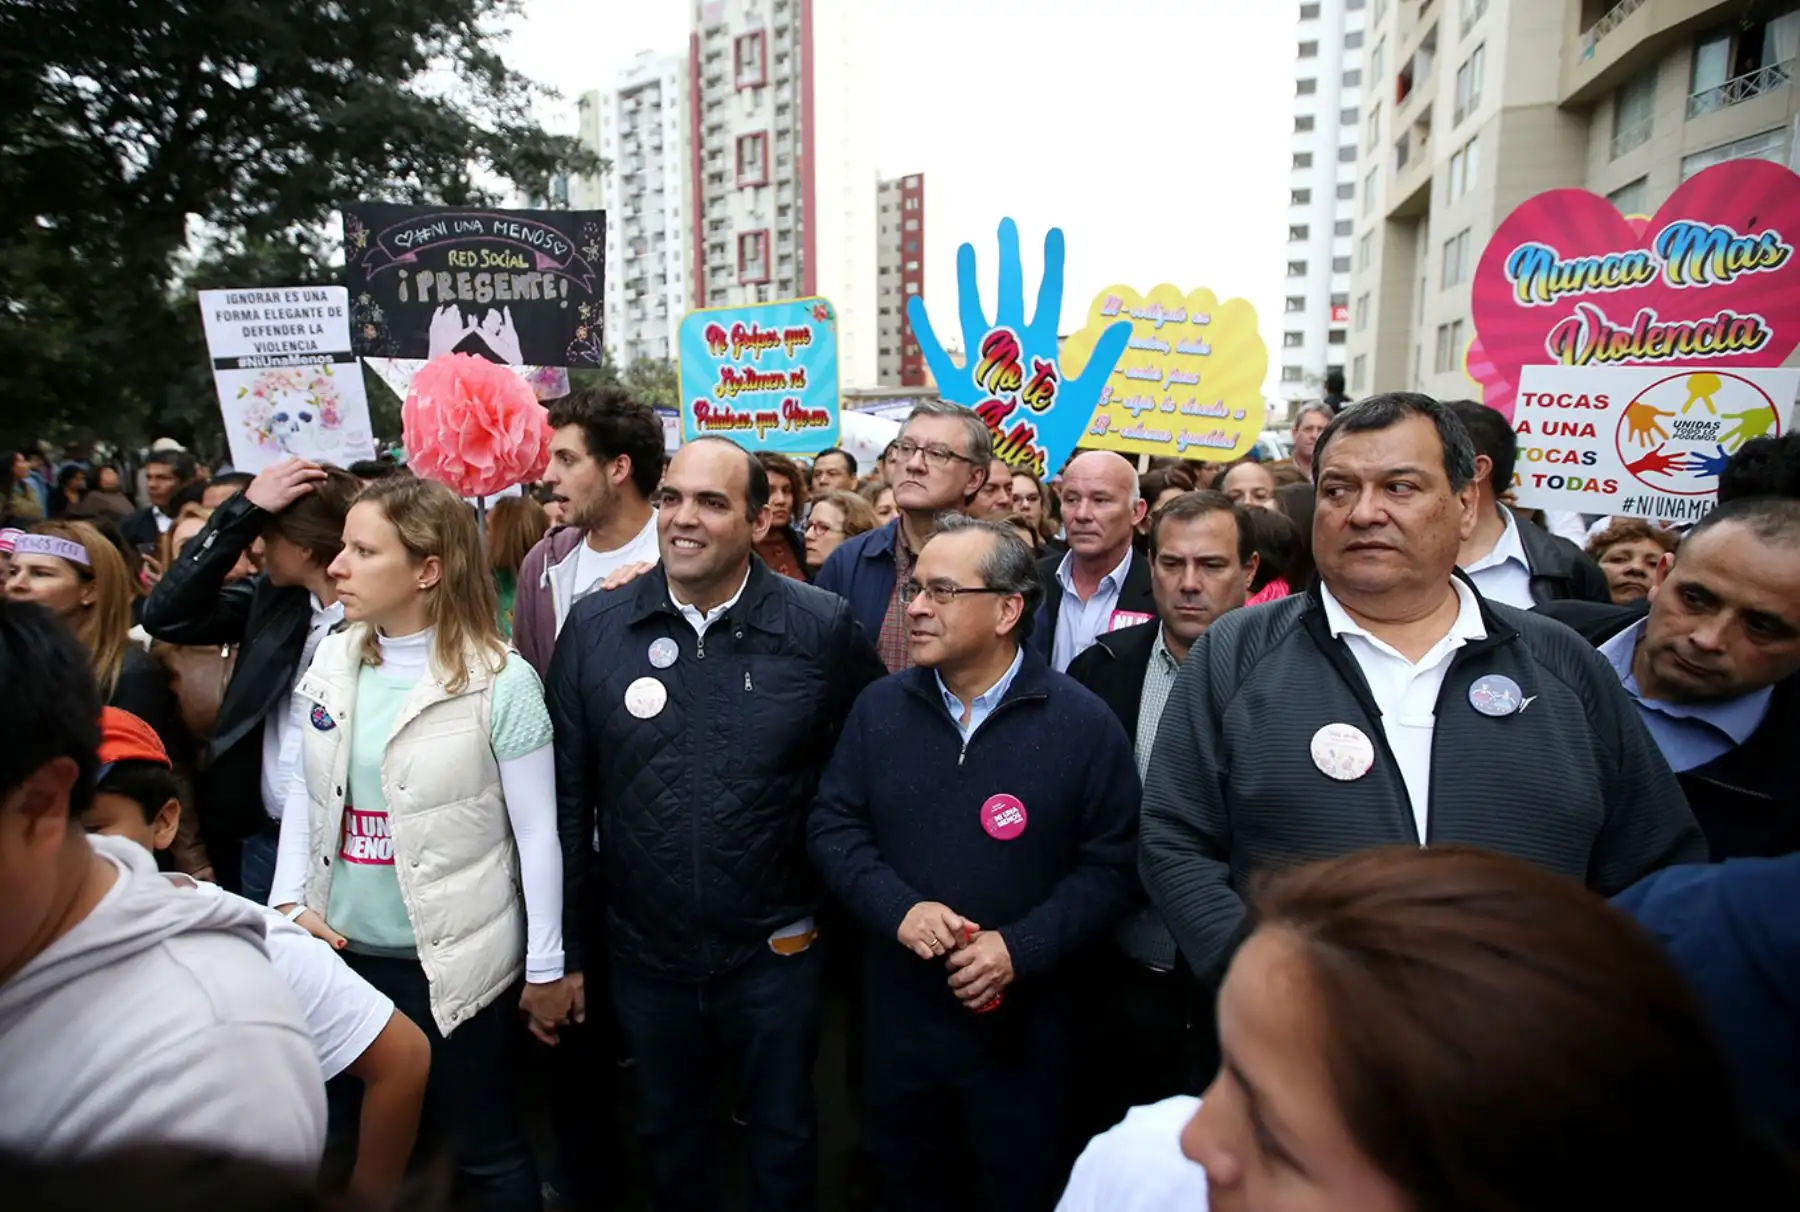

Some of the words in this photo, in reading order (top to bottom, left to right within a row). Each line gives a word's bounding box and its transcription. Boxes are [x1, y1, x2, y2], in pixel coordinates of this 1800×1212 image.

[414, 220, 448, 243] #NI
[454, 219, 484, 234] UNA
[493, 221, 555, 248] MENOS
[448, 249, 478, 267] RED
[1508, 244, 1656, 303] Nunca
[226, 291, 281, 305] IGNORAR
[285, 291, 300, 303] ES
[303, 290, 329, 302] UNA
[216, 309, 261, 322] FORMA
[264, 306, 322, 320] ELEGANTE
[327, 306, 343, 318] DE
[242, 324, 305, 338] DEFENDER
[310, 323, 324, 335] LA
[1549, 304, 1768, 366] Violencia
[254, 340, 318, 353] VIOLENCIA
[237, 353, 334, 370] #NiUnaMenos
[975, 329, 1023, 396] No
[1021, 359, 1058, 412] te
[1522, 393, 1610, 410] TOCAS
[1516, 420, 1532, 434] A
[1541, 421, 1597, 438] UNA
[1673, 420, 1721, 430] UNIDAS
[1516, 446, 1598, 466] TOCAS
[1531, 474, 1619, 495] TODAS
